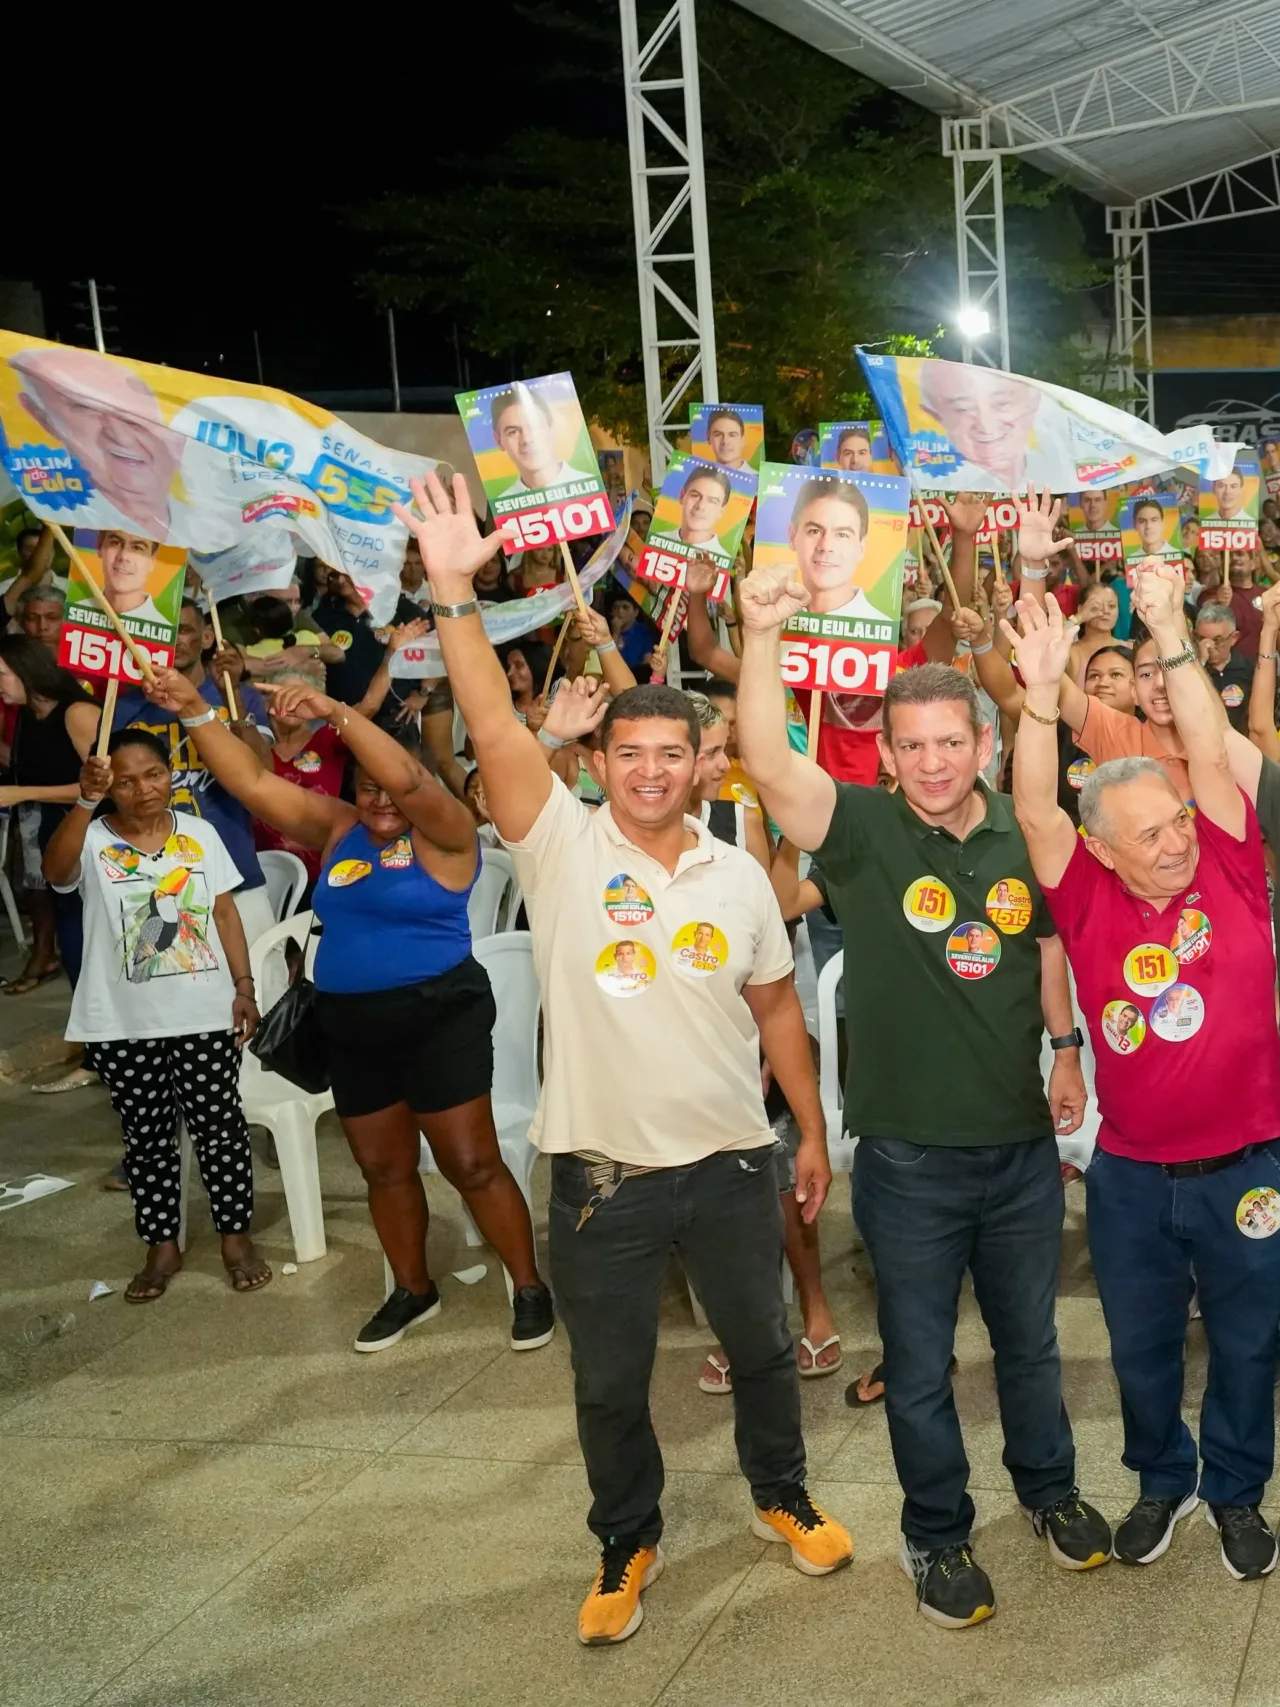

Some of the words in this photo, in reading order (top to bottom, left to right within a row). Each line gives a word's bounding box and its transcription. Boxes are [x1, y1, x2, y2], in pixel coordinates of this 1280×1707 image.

[909, 438, 950, 453] JULIM
[10, 456, 73, 471] JULIM
[22, 472, 84, 494] Lula
[31, 468, 48, 481] do
[770, 471, 832, 482] DEPUTADO
[839, 478, 900, 490] ESTADUAL
[495, 492, 545, 514] SEVERO
[502, 497, 611, 549] 15101
[910, 504, 950, 526] 101
[334, 525, 385, 552] EDRO
[649, 536, 688, 556] SEVERO
[1201, 530, 1256, 550] 15101
[338, 549, 380, 570] CHA
[644, 551, 726, 598] 1511
[781, 615, 819, 633] VERO
[780, 641, 890, 691] 5101
[1070, 778, 1086, 787] 1510
[918, 886, 947, 916] 151
[613, 911, 648, 923] 15101
[988, 908, 1031, 925] 1515
[679, 948, 719, 965] Castro
[951, 952, 972, 961] SEVERO
[1182, 937, 1210, 962] 15101
[955, 961, 988, 975] 15101
[1134, 954, 1167, 980] 151
[1117, 1034, 1132, 1052] 13
